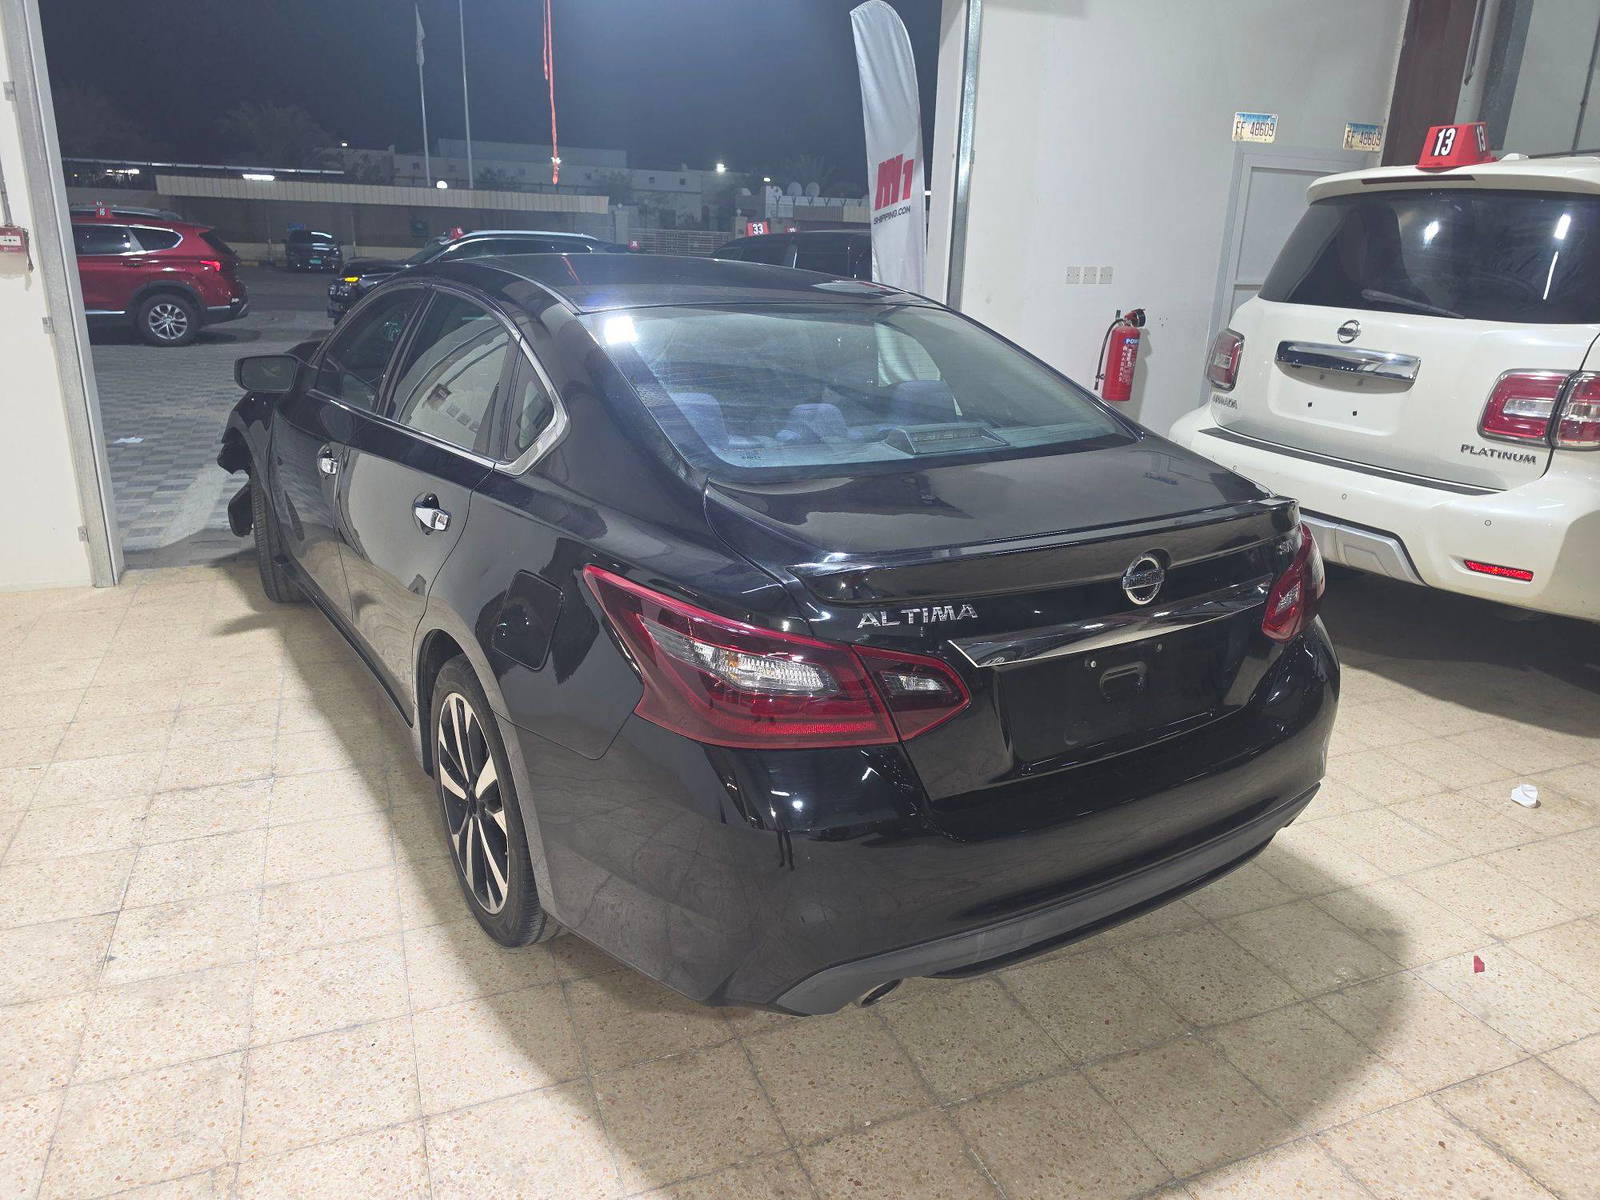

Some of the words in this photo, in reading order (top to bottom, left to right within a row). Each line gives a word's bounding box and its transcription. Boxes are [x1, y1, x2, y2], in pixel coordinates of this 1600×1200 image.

[1249, 121, 1275, 138] 48609
[1433, 127, 1457, 156] 13
[1476, 125, 1487, 153] 13
[875, 154, 914, 211] M1
[752, 223, 764, 235] 33
[1460, 444, 1537, 465] PLATINUM
[856, 603, 979, 629] ALTIMA
